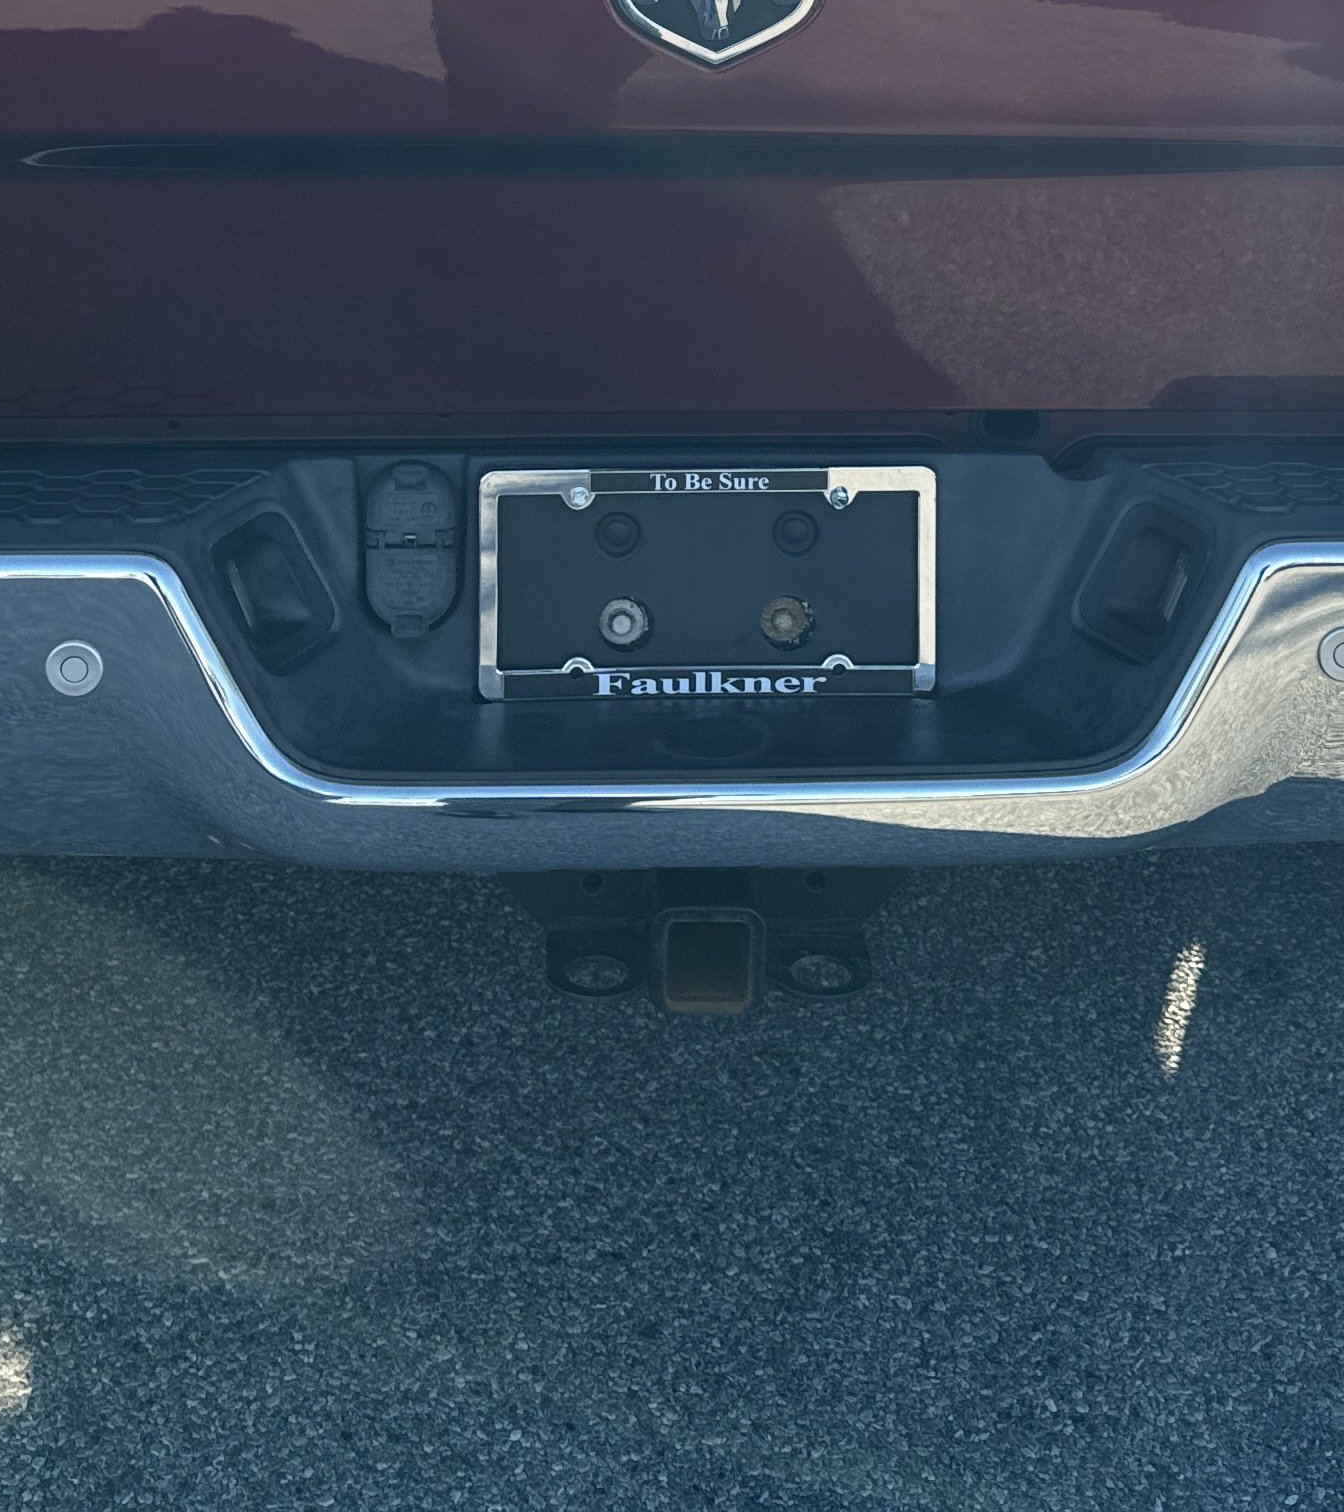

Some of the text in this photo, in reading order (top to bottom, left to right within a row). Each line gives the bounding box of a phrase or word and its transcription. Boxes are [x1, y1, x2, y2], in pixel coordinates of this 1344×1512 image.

[649, 472, 770, 490] To Be Sure
[592, 671, 828, 696] Faulkner
